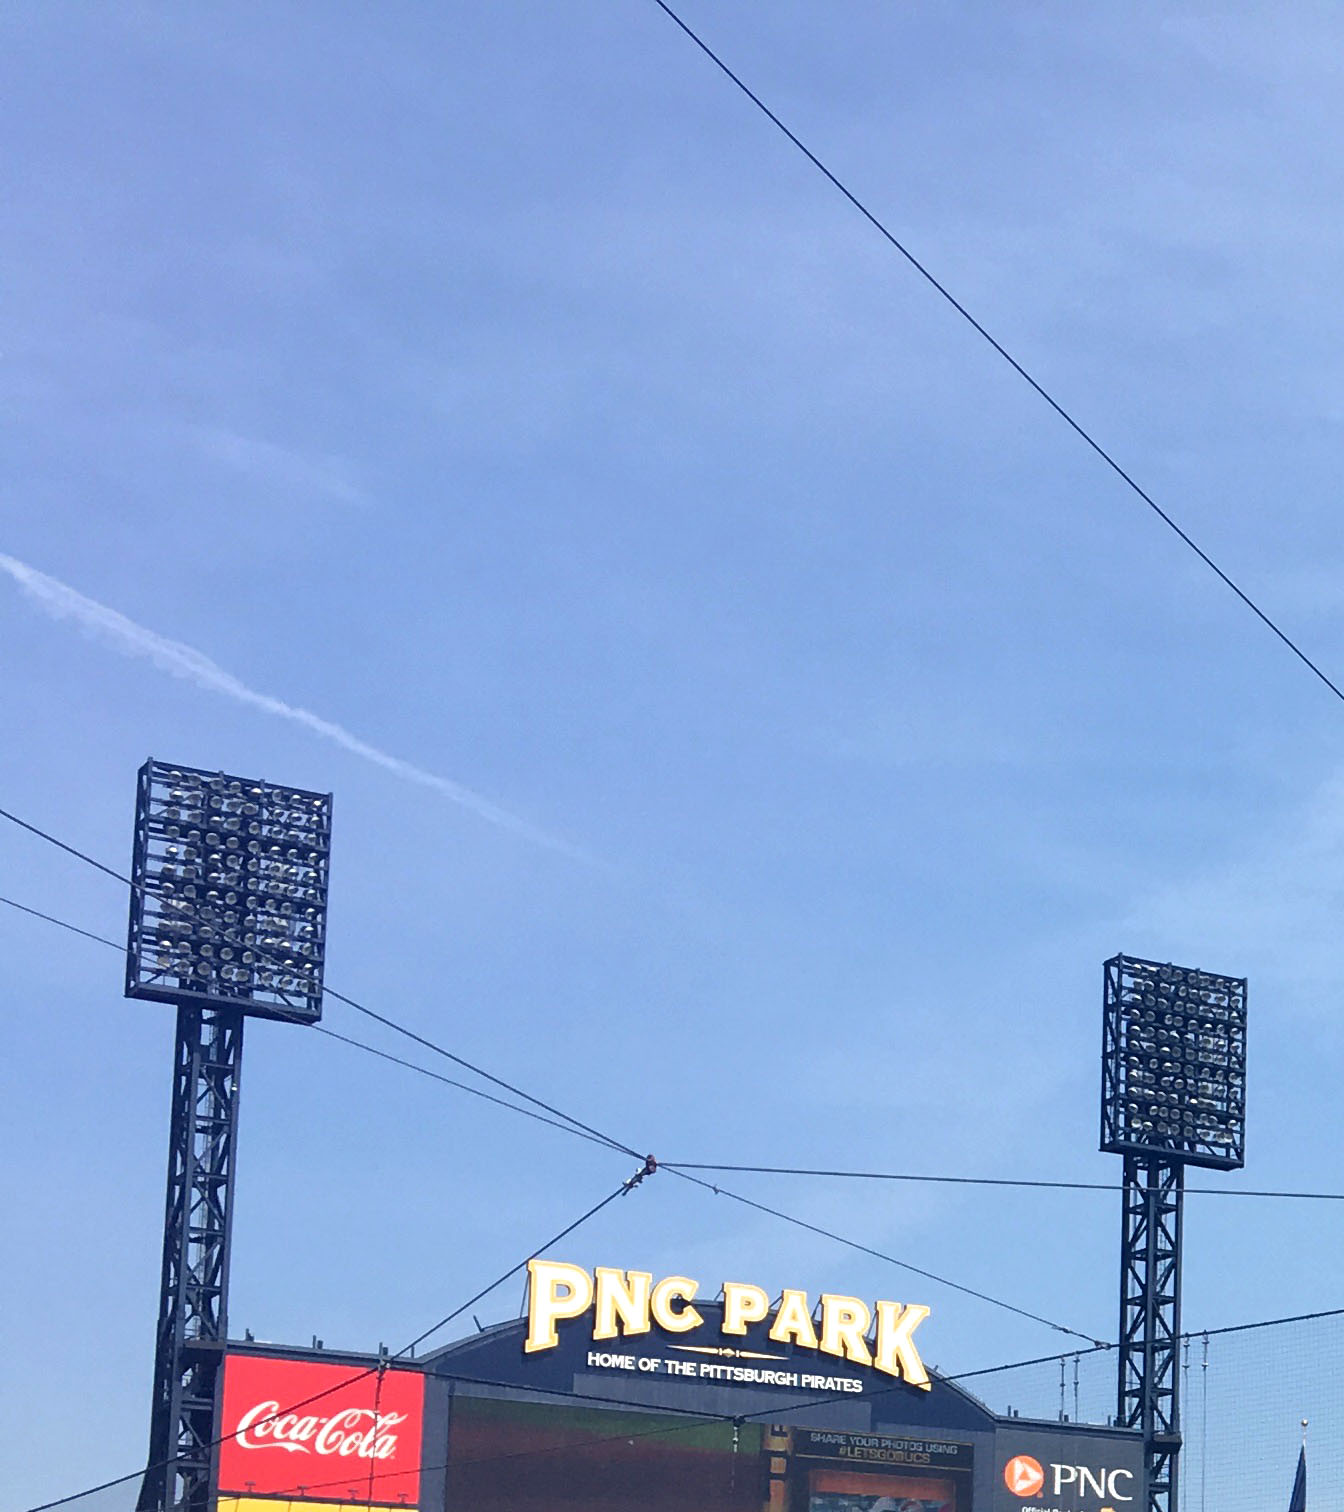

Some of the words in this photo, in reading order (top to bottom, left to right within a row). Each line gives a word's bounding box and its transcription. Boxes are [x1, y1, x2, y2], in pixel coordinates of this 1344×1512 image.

[524, 1259, 704, 1354] PNC
[720, 1281, 931, 1391] PARK
[587, 1350, 636, 1371] HOME
[639, 1357, 661, 1372] OF
[664, 1359, 698, 1377] THE
[699, 1364, 799, 1387] PITTSBURGH
[801, 1374, 863, 1393] PIRATES
[236, 1401, 408, 1460] Coca-Cola
[810, 1432, 847, 1444] SHARE
[850, 1436, 879, 1448] YOUR
[881, 1438, 923, 1452] PHOTOS
[926, 1441, 958, 1455] USING
[1050, 1463, 1134, 1501] PNC
